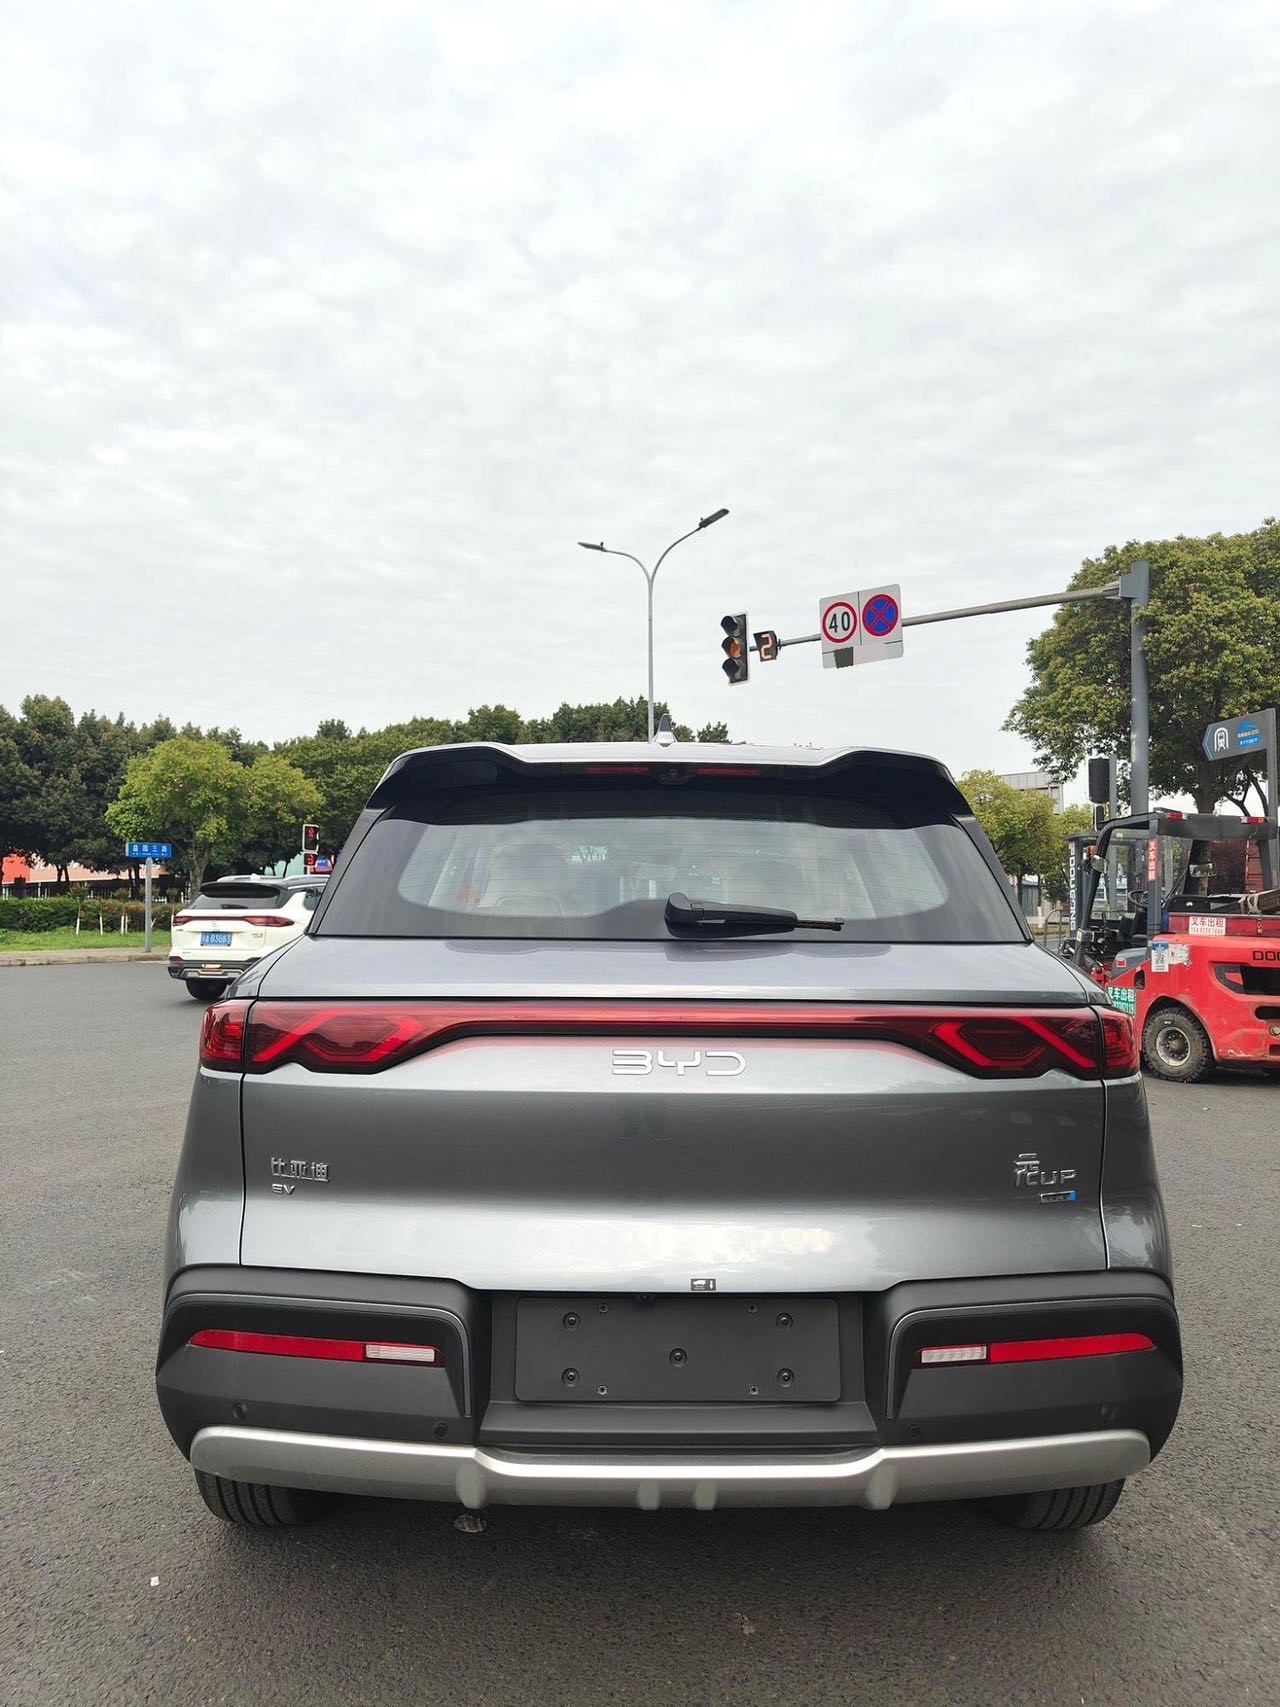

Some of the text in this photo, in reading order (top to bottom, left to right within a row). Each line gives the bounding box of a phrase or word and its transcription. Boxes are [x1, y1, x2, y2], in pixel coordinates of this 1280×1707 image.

[829, 612, 851, 633] 40
[761, 633, 773, 660] 2
[1191, 916, 1224, 928] 叉车出租
[611, 1049, 747, 1077] BYD
[270, 1156, 330, 1183] 比亚迪
[271, 1183, 296, 1196] EV
